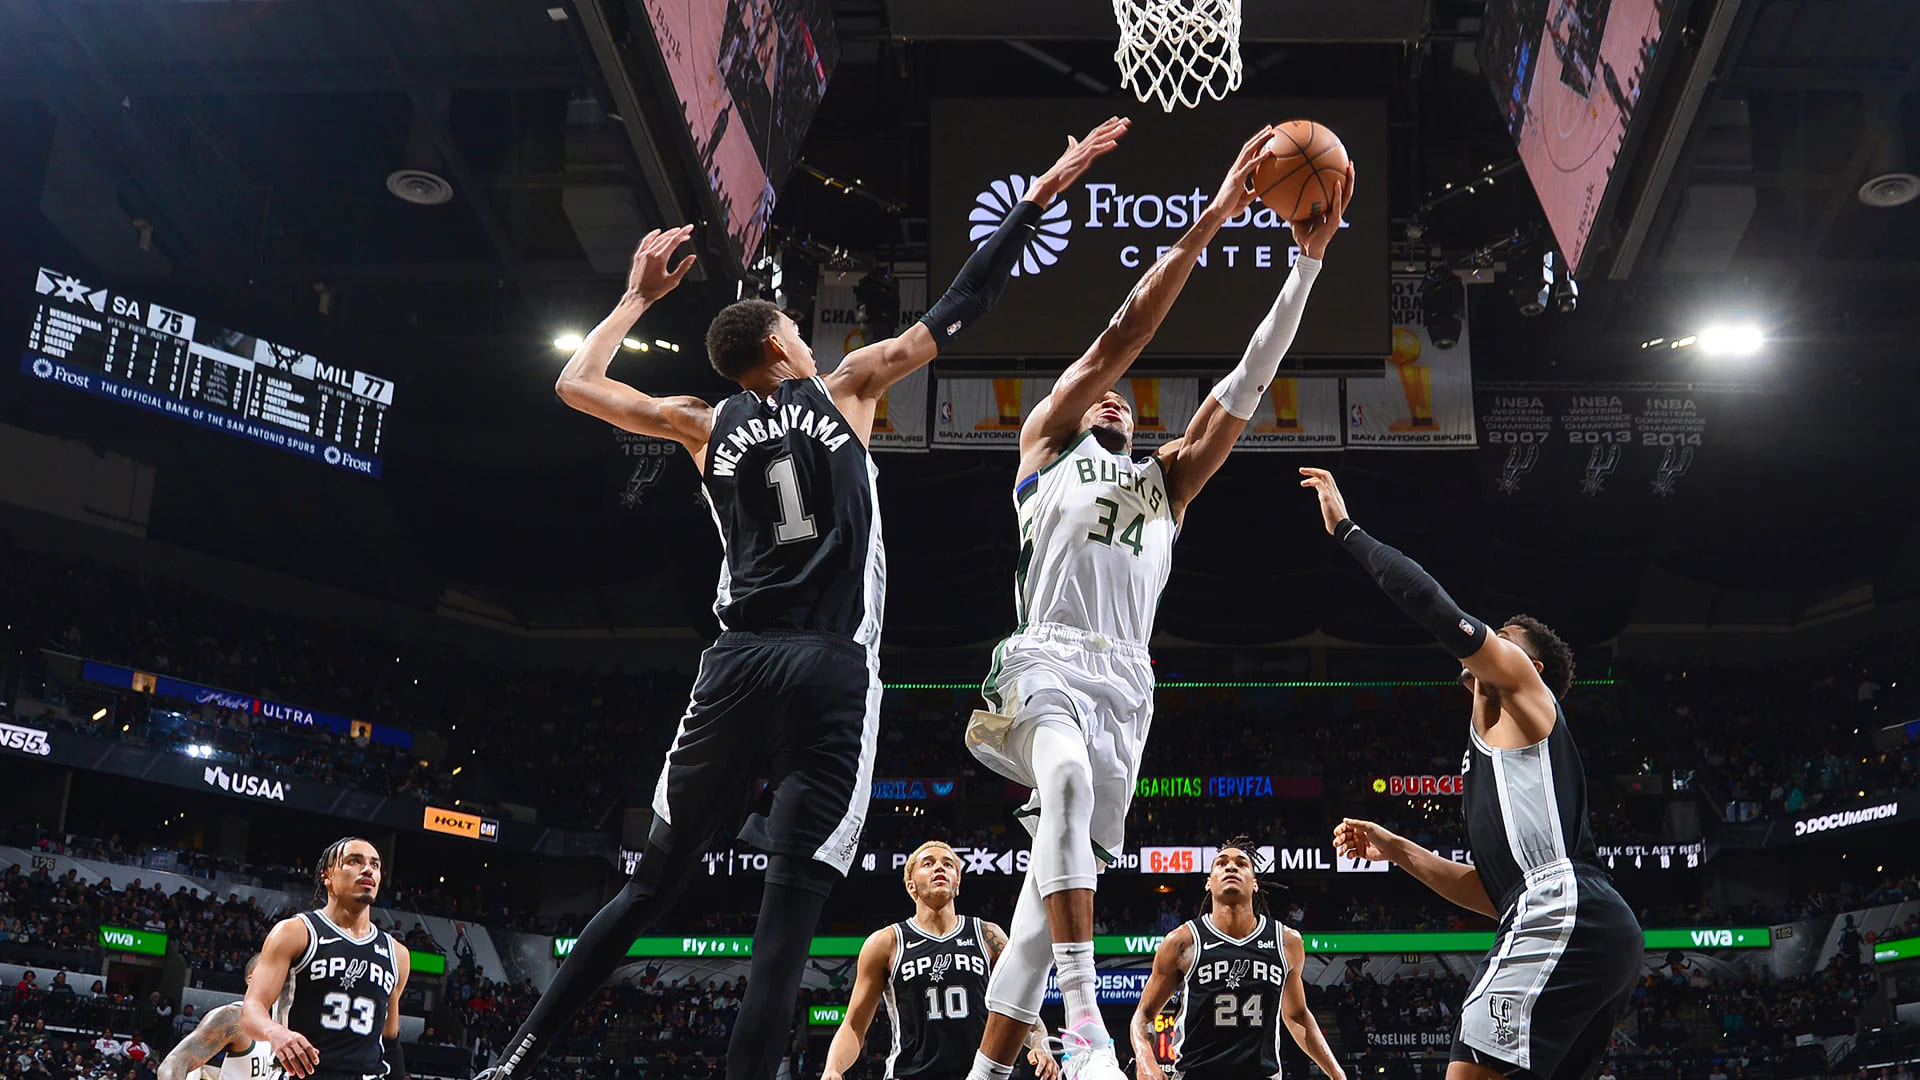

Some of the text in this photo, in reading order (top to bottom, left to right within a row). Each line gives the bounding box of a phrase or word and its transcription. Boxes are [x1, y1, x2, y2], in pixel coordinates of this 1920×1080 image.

[1085, 184, 1207, 228] Frost
[112, 296, 184, 334] SA 75
[54, 366, 90, 389] Frost
[316, 361, 386, 399] MIL 77
[101, 381, 316, 454] THE OFFICIAL BANK OF THE SAN ANTONIO SPURS
[886, 434, 924, 443] SPURS
[938, 431, 1016, 440] SAN ANTONIO
[1244, 434, 1295, 442] ANTONIO
[1298, 434, 1336, 442] SPURS
[1351, 434, 1472, 442] SAN ANTONIO SPURS
[1488, 432, 1549, 444] 2007
[1568, 431, 1632, 443] 2013
[1642, 432, 1703, 446] 2014
[620, 443, 677, 456] 1999
[342, 452, 372, 473] Frost
[1076, 458, 1163, 514] BUCKS
[764, 454, 818, 546] 1
[1087, 496, 1146, 558] 34
[263, 704, 314, 726] ULTRA
[232, 772, 284, 802] USAA
[434, 816, 496, 836] HOLT CAT
[1806, 802, 1898, 834] DOCUMATION
[1150, 850, 1193, 873] 6:45
[1281, 848, 1331, 870] MIL
[1625, 846, 1648, 856] STL
[1652, 846, 1676, 856] AST
[34, 857, 54, 870] 126
[682, 938, 707, 956] Fly
[710, 940, 726, 952] to
[924, 985, 970, 1020] 10
[1214, 994, 1263, 1027] 24
[320, 992, 375, 1036] 33
[1420, 1032, 1451, 1045] BUMS
